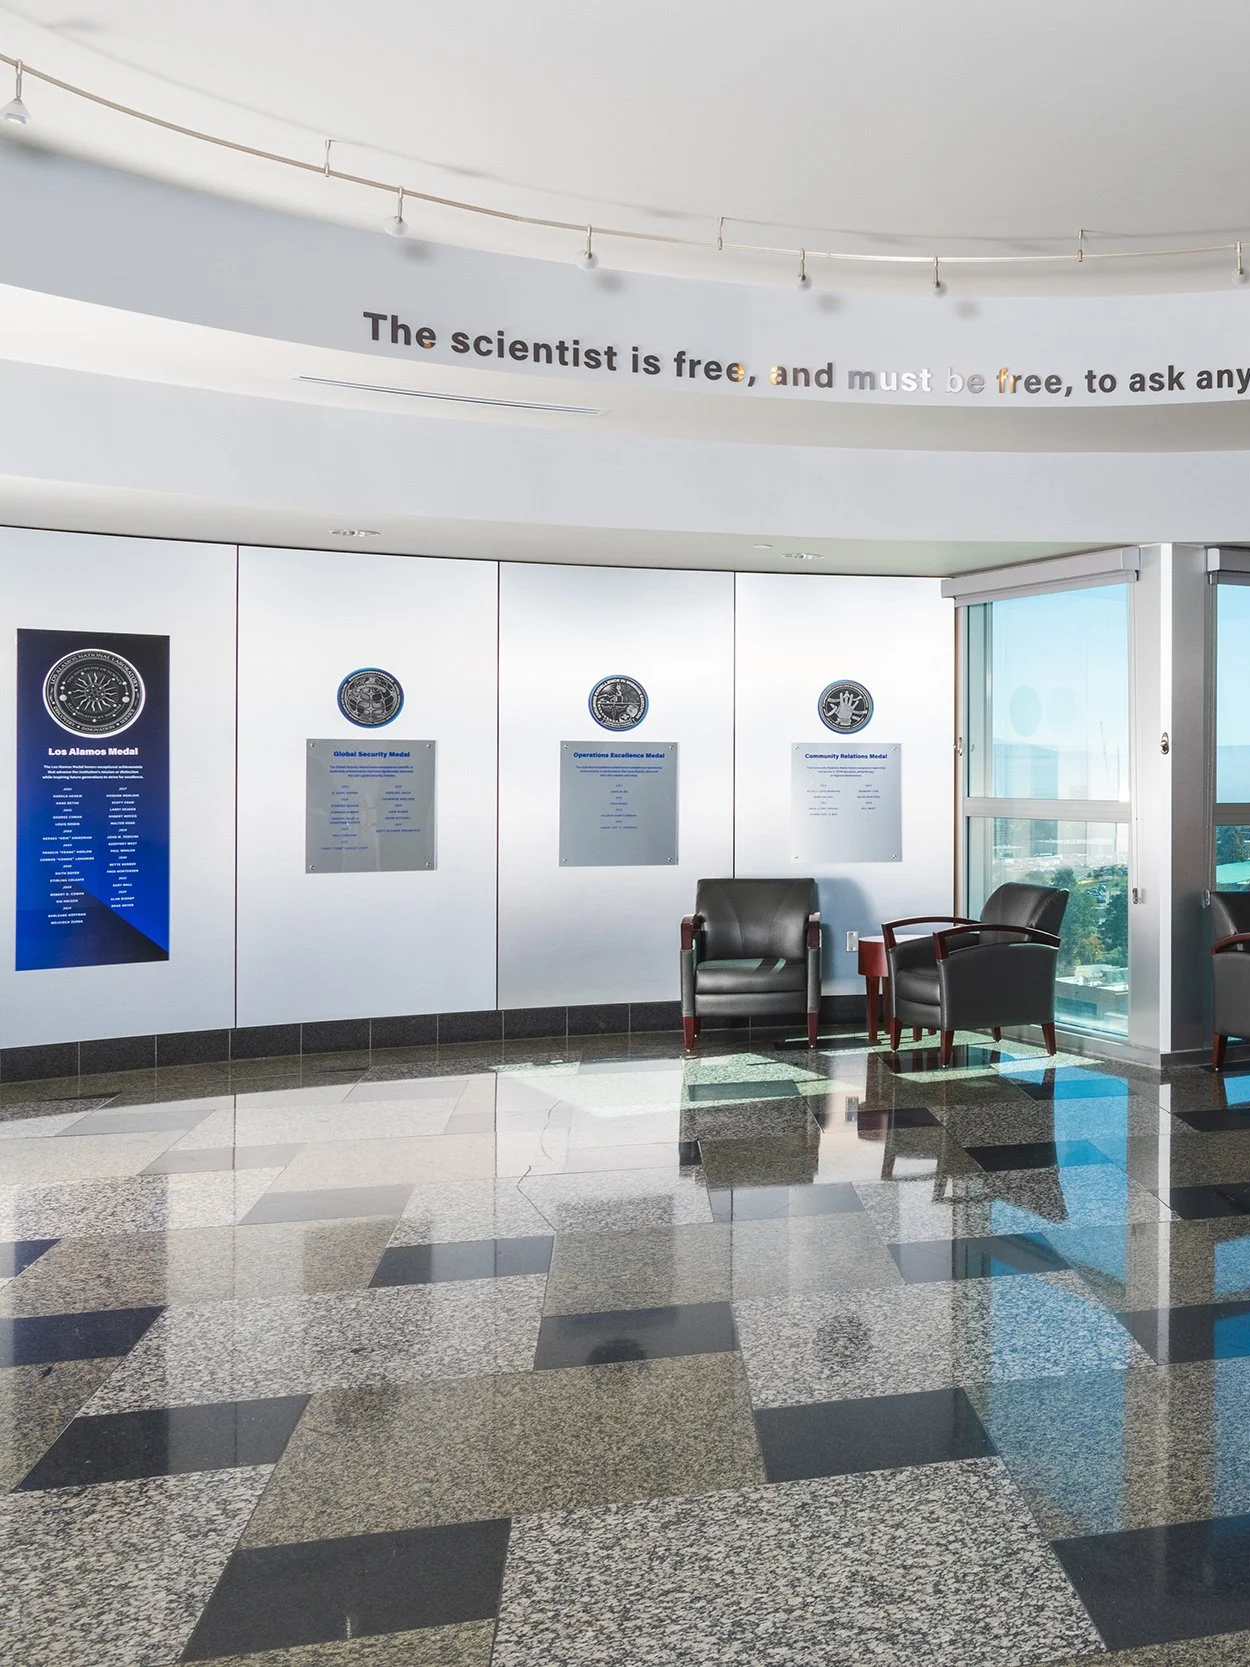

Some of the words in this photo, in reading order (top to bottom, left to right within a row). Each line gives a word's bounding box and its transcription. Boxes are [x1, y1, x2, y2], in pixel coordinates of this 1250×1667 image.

[363, 311, 437, 349] The
[451, 330, 617, 372] scientist
[631, 346, 661, 376] is
[674, 350, 757, 387] free,
[769, 362, 834, 389] and
[848, 367, 933, 393] must
[944, 367, 986, 394] be
[997, 367, 1073, 397] free,
[1085, 368, 1117, 393] to
[1130, 365, 1185, 393] ask
[48, 748, 68, 756] Los
[68, 748, 106, 756] Alamos
[108, 748, 138, 756] Medal
